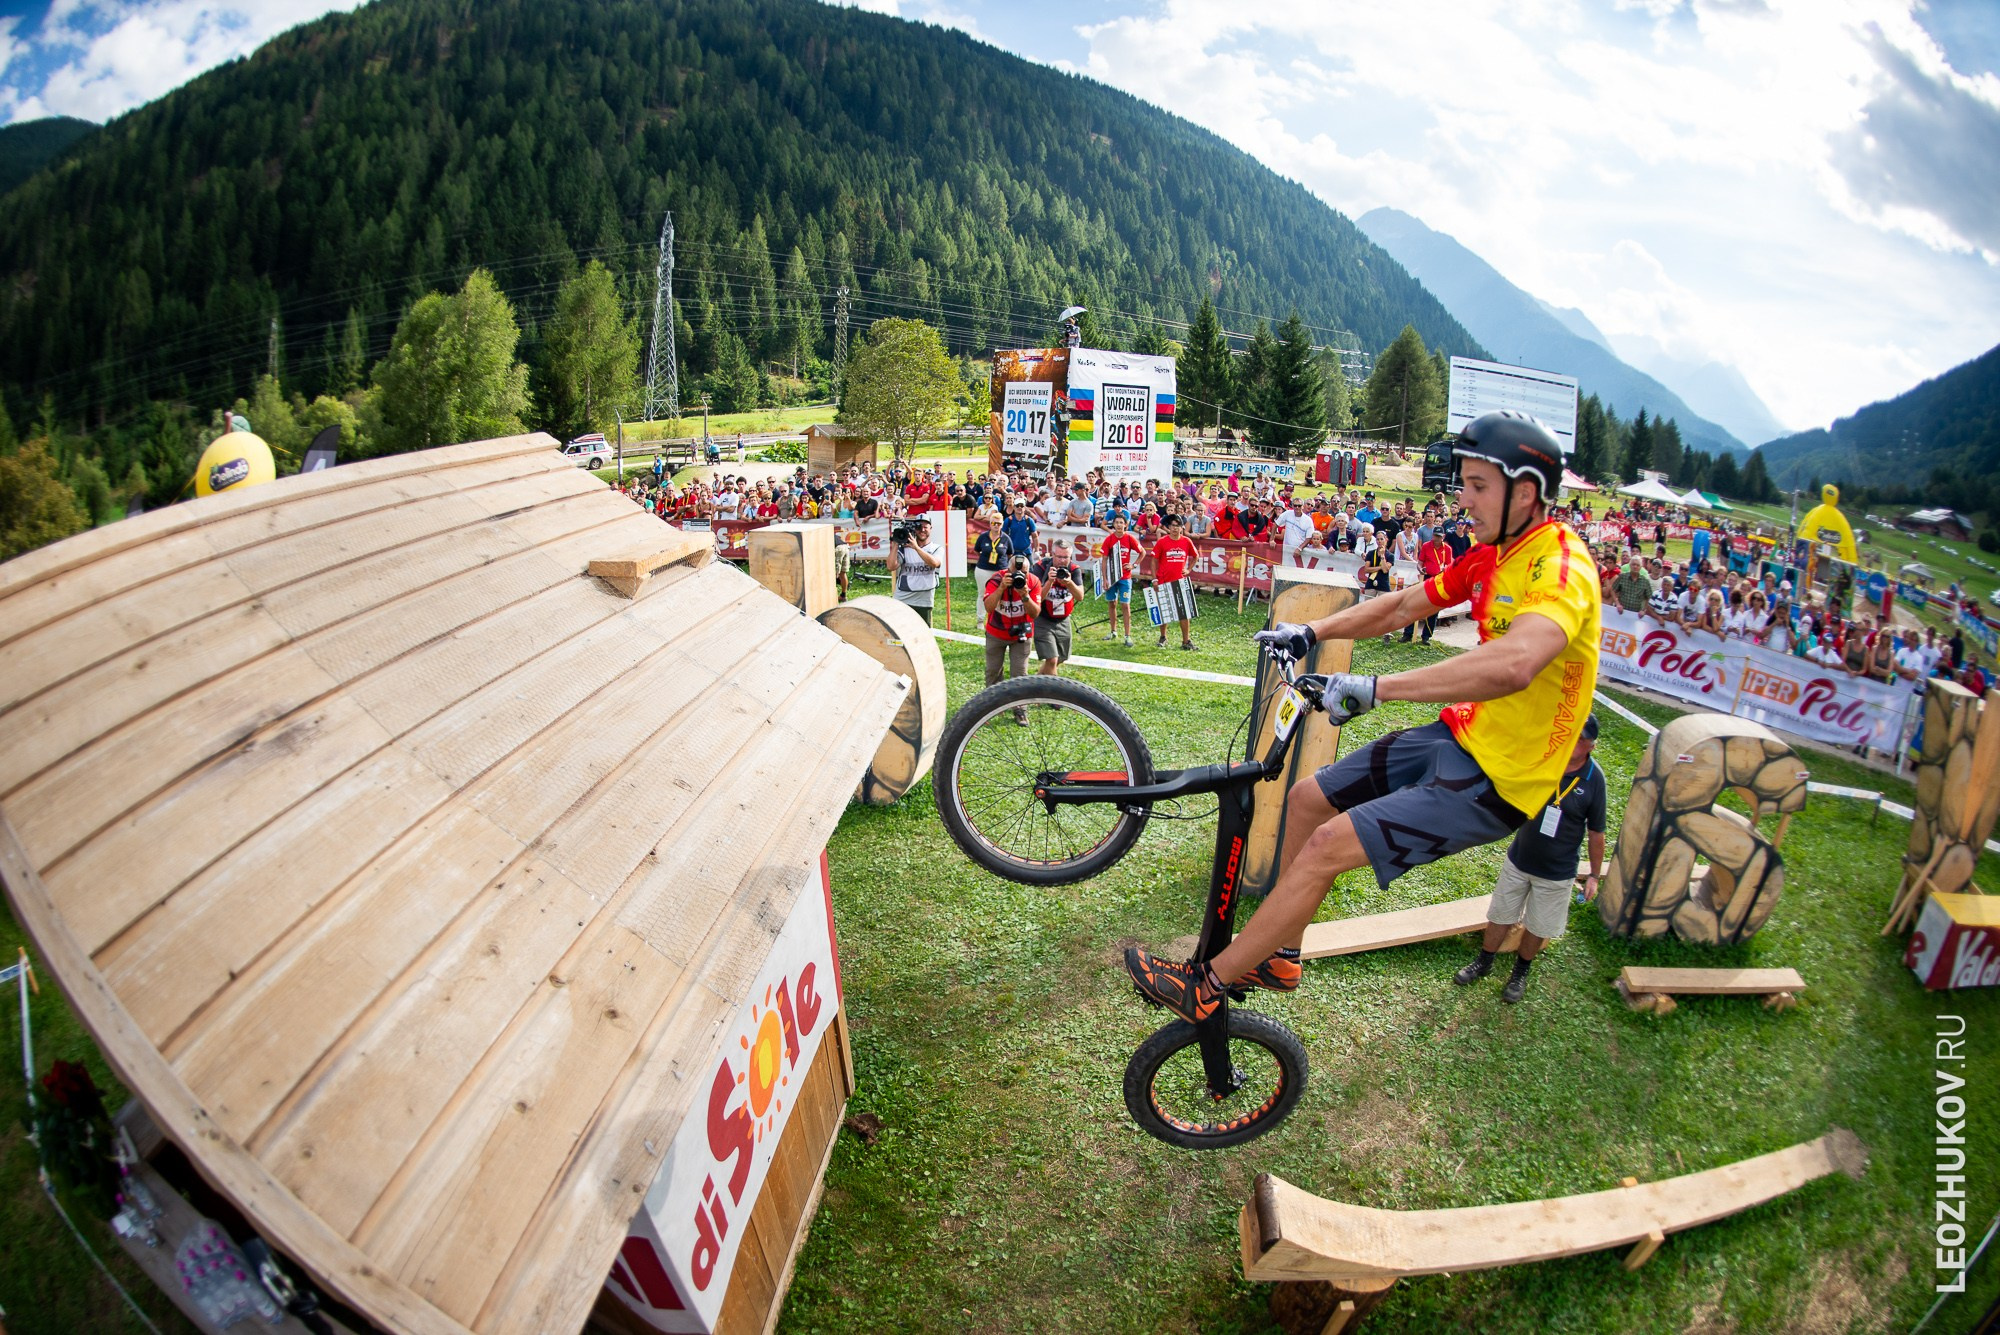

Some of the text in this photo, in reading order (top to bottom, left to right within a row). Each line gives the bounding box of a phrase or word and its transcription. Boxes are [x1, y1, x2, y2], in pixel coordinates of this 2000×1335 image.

[1107, 396, 1145, 412] WORLD
[1007, 409, 1047, 435] 2017
[1107, 413, 1144, 422] CHAMPIONSHIPS
[1107, 423, 1143, 444] 2016
[1115, 453, 1123, 462] 4X
[1128, 453, 1148, 462] TRIALS
[1000, 604, 1025, 614] PHOT
[1744, 671, 1793, 703] IPER
